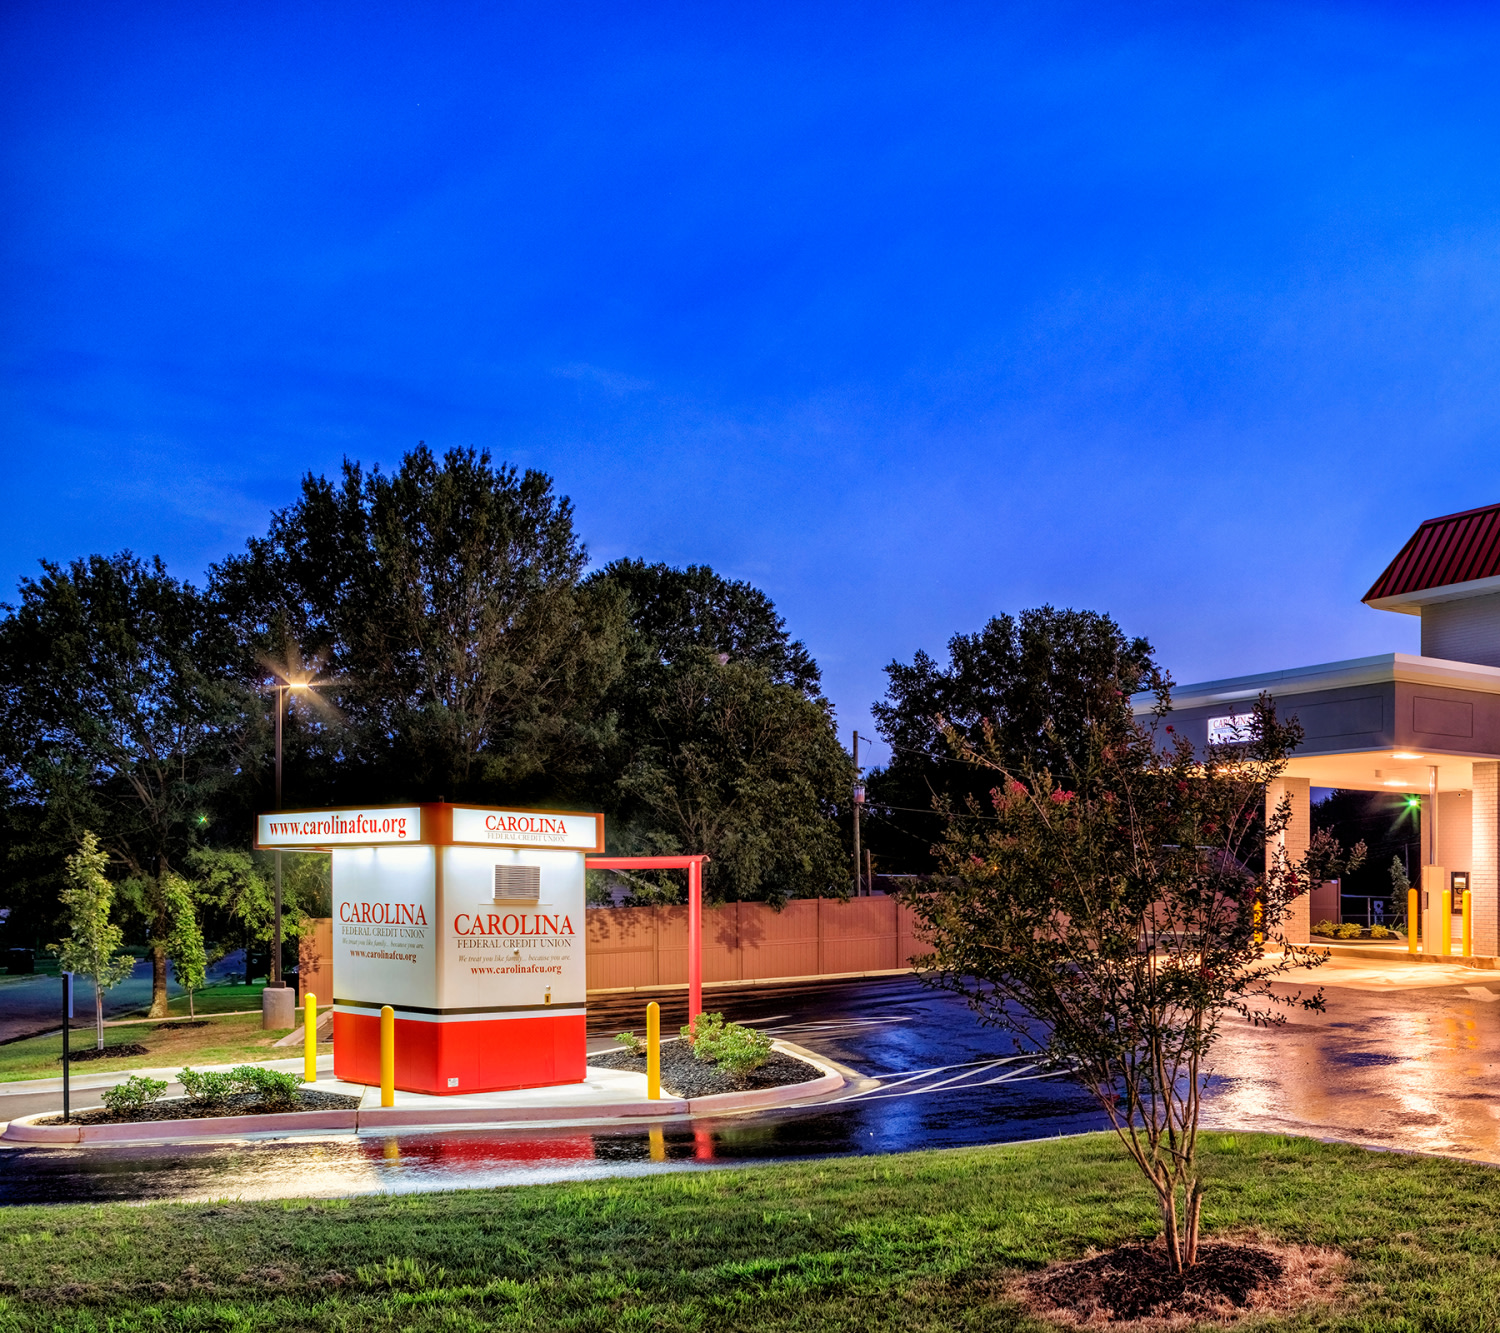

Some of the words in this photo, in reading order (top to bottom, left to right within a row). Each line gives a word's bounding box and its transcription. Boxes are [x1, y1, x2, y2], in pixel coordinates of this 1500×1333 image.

[269, 814, 406, 838] www.carolinafcu.org
[485, 815, 567, 833] CAROLINA
[487, 832, 518, 840] FEDERAL
[518, 833, 541, 841] CREDIT
[340, 902, 428, 925] CAROLINA
[454, 914, 575, 935] CAROLINA
[342, 926, 371, 936] FEDERAL
[372, 928, 399, 937] CREDIT
[400, 929, 425, 938] UNION
[457, 939, 501, 948] FEDERAL
[503, 939, 537, 948] CREDIT
[540, 939, 572, 948] UNION
[350, 950, 417, 964] www.carolinafcu.org
[471, 964, 562, 975] www.carolinafcu.org
